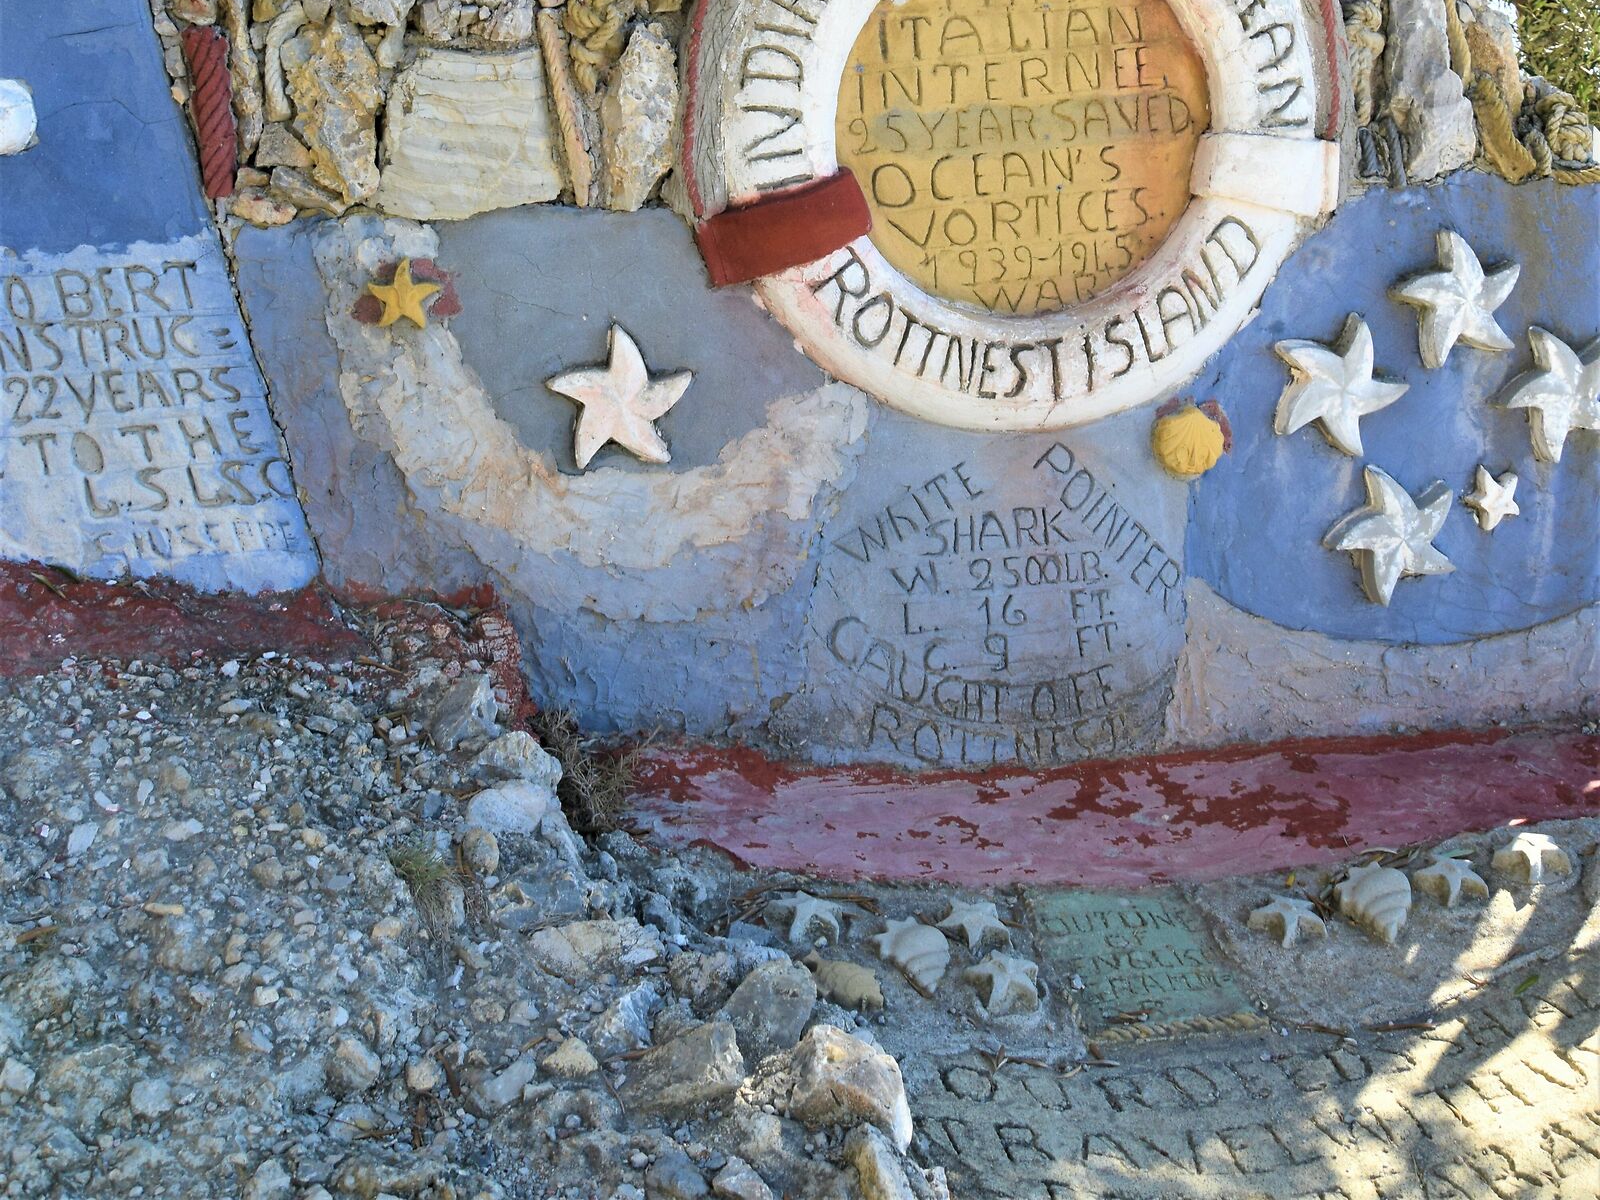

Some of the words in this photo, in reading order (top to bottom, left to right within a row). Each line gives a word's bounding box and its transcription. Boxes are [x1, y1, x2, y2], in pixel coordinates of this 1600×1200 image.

[877, 4, 1145, 63] ITALIAN
[809, 245, 1064, 402] ROTTNEST
[1080, 215, 1261, 391] ISLAND
[19, 431, 105, 476] TO
[117, 410, 260, 464] THE
[921, 506, 1075, 557] SHARK
[1032, 441, 1182, 614] POINTER
[976, 593, 1028, 629] 16
[827, 615, 1009, 724] CAUGHT
[982, 631, 1012, 676] 9
